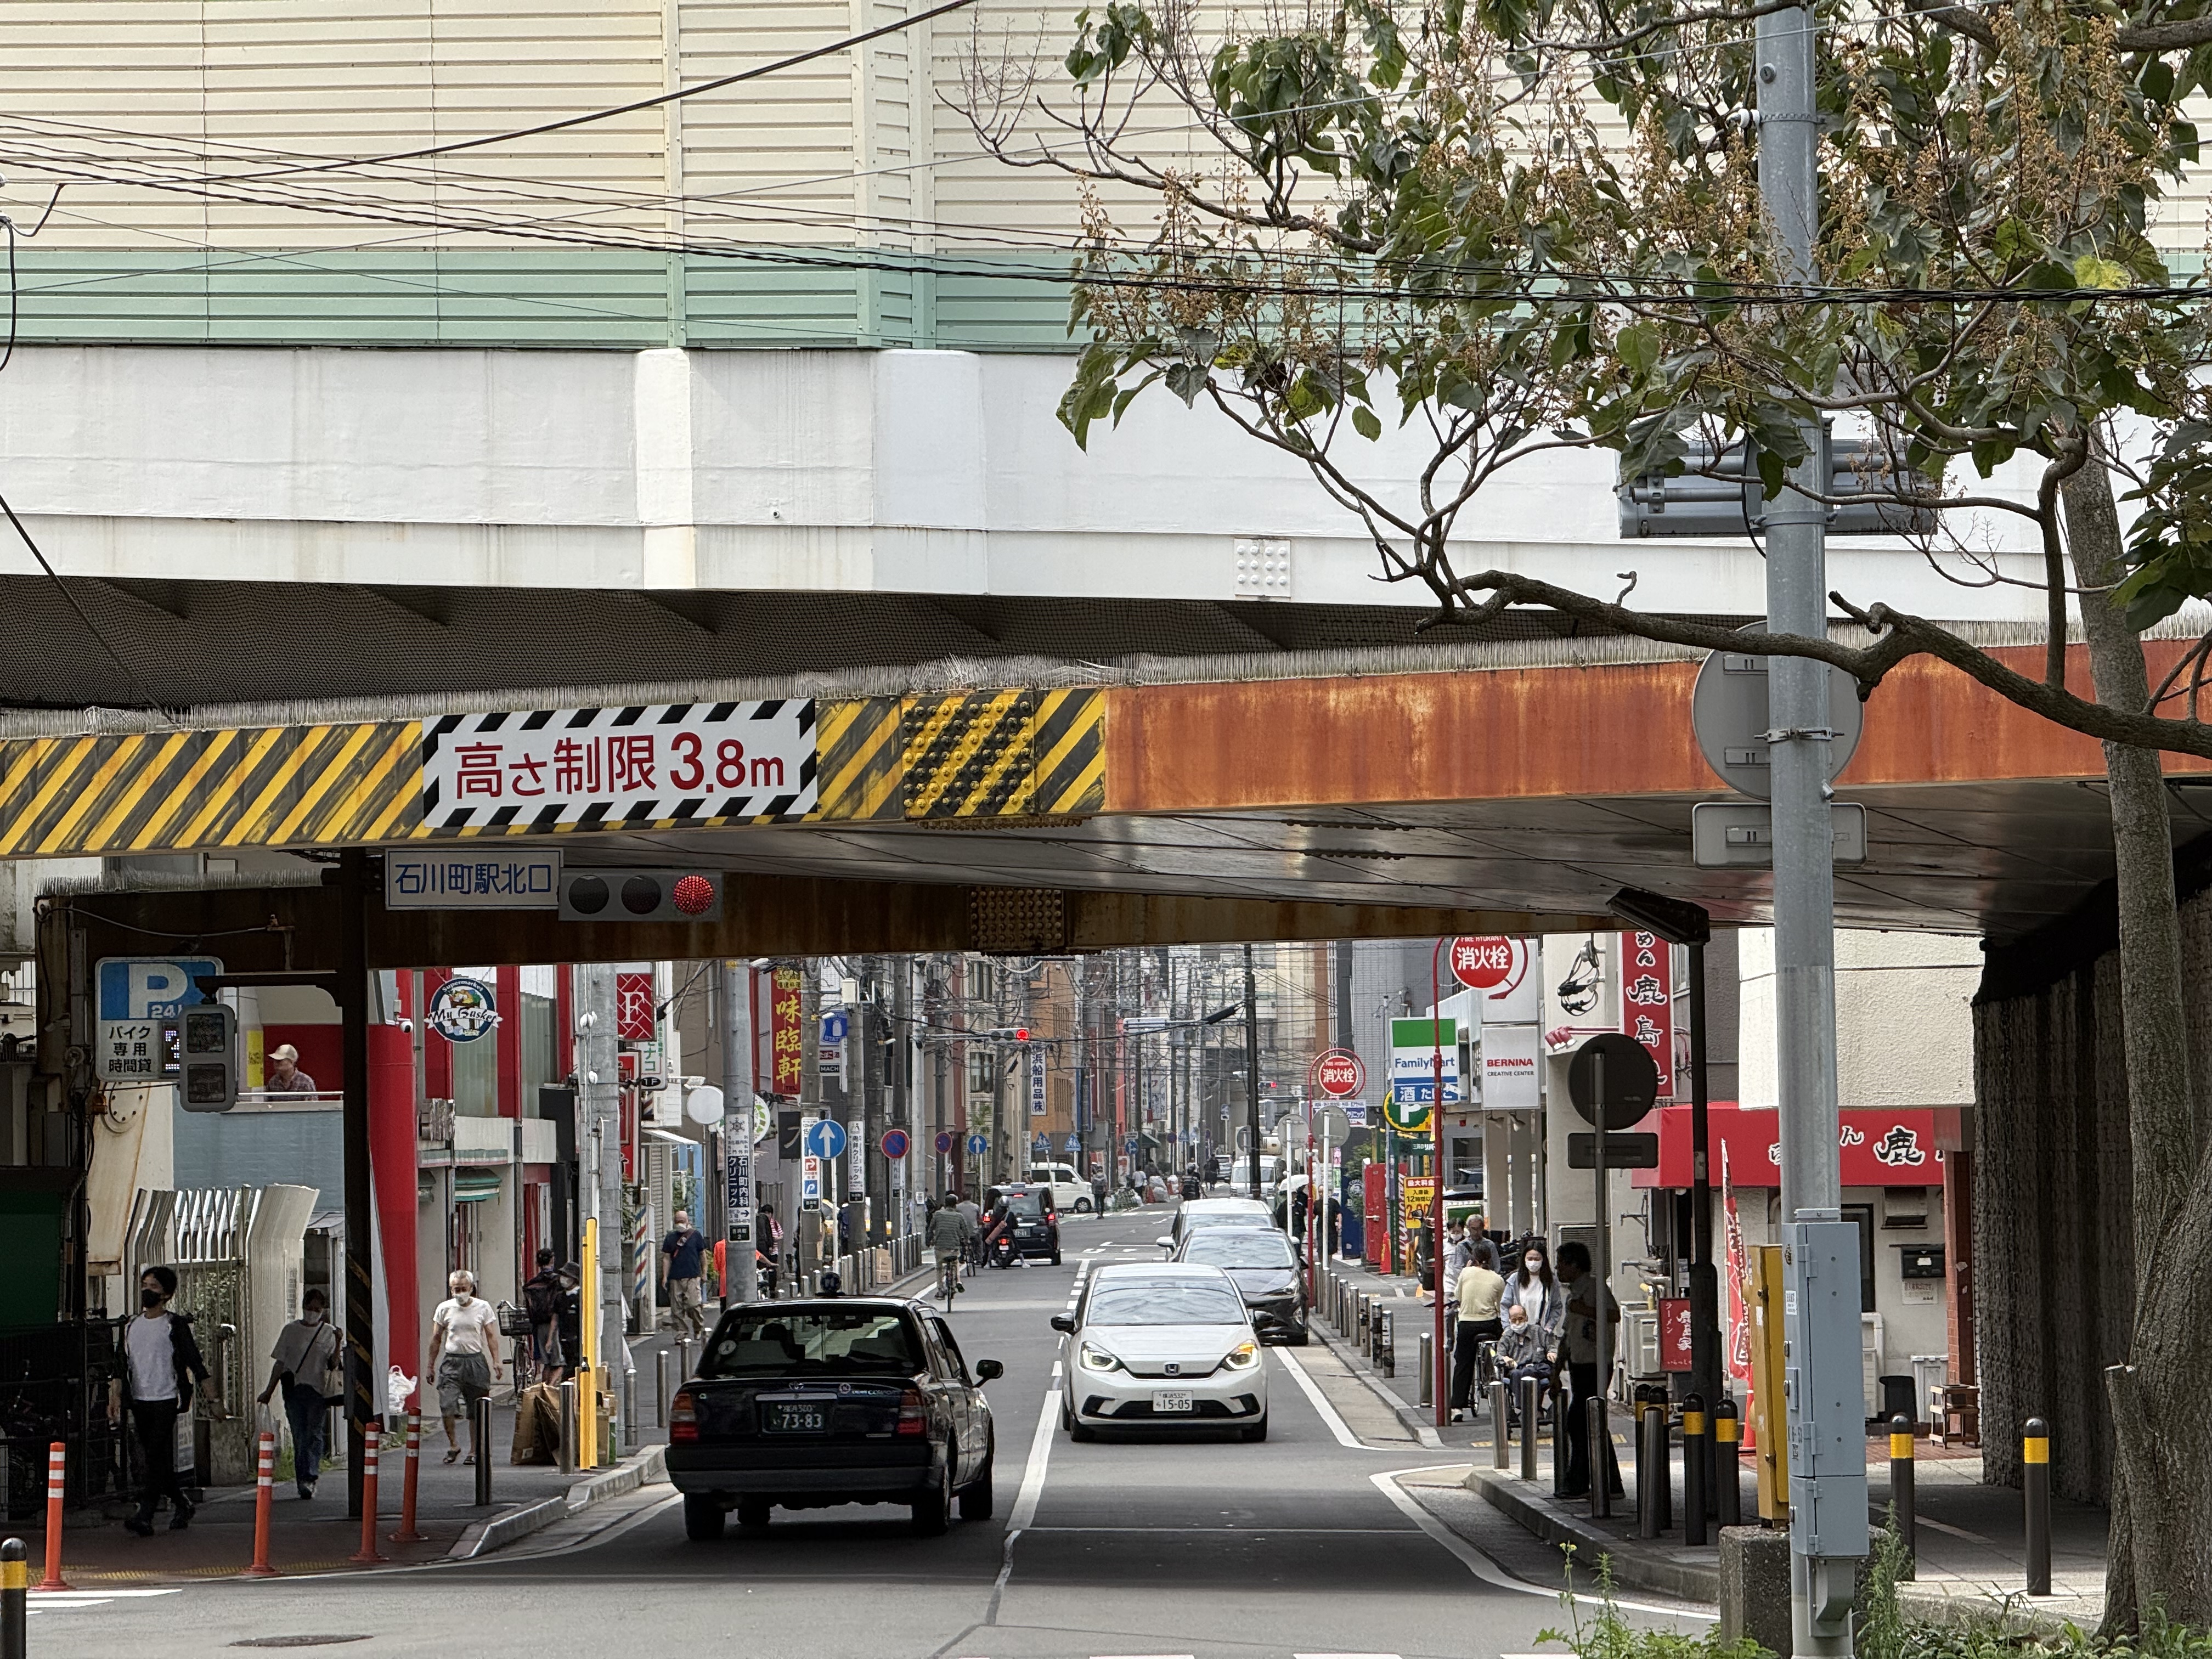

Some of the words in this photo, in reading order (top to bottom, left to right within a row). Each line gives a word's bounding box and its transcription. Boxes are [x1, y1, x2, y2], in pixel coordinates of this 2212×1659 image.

[454, 736, 657, 799] 高さ制限
[670, 732, 785, 793] 3.8m
[395, 864, 551, 895] 石川町駅北口
[1457, 945, 1509, 970] 消火栓
[128, 963, 188, 1019] P
[442, 980, 483, 992] Supermarket
[428, 1009, 452, 1023] My
[458, 1007, 497, 1023] Basket
[622, 991, 645, 1024] F
[109, 1026, 151, 1040] バイク
[113, 1042, 146, 1057] 専用
[109, 1059, 152, 1073] 時間貸
[1487, 1058, 1534, 1067] BERNINA
[1323, 1068, 1355, 1083] 消火栓
[1400, 1086, 1415, 1102] 酒
[729, 1157, 737, 1206] クリニック
[738, 1156, 748, 1206] 石川町内科
[1163, 1399, 1190, 1410] 15-05
[781, 1413, 822, 1429] 73-83
